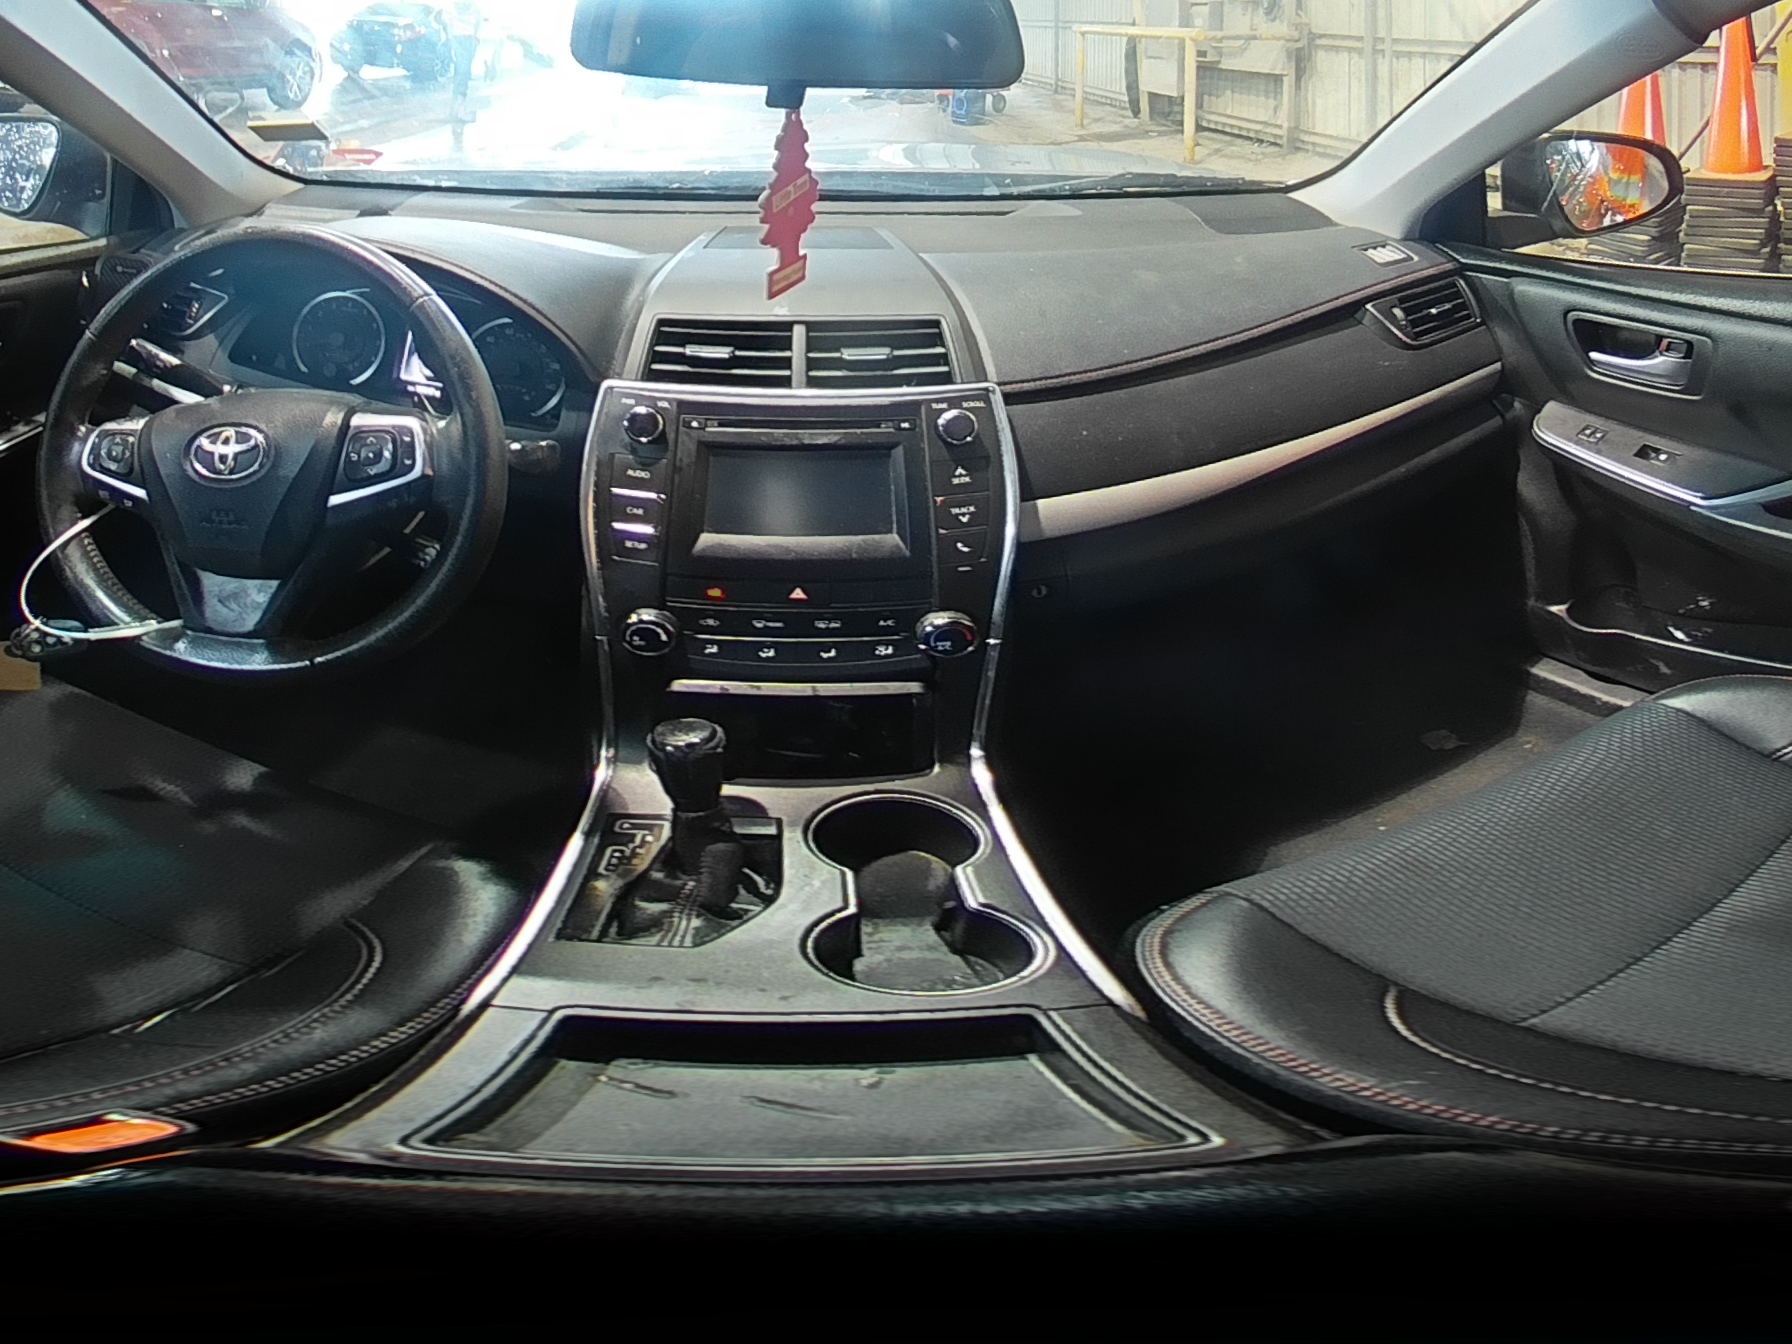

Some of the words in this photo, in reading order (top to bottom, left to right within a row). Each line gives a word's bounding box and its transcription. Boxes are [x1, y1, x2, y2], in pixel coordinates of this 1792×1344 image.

[626, 469, 650, 478] AUDIO
[626, 506, 644, 515] CAR
[950, 505, 976, 514] TRACK
